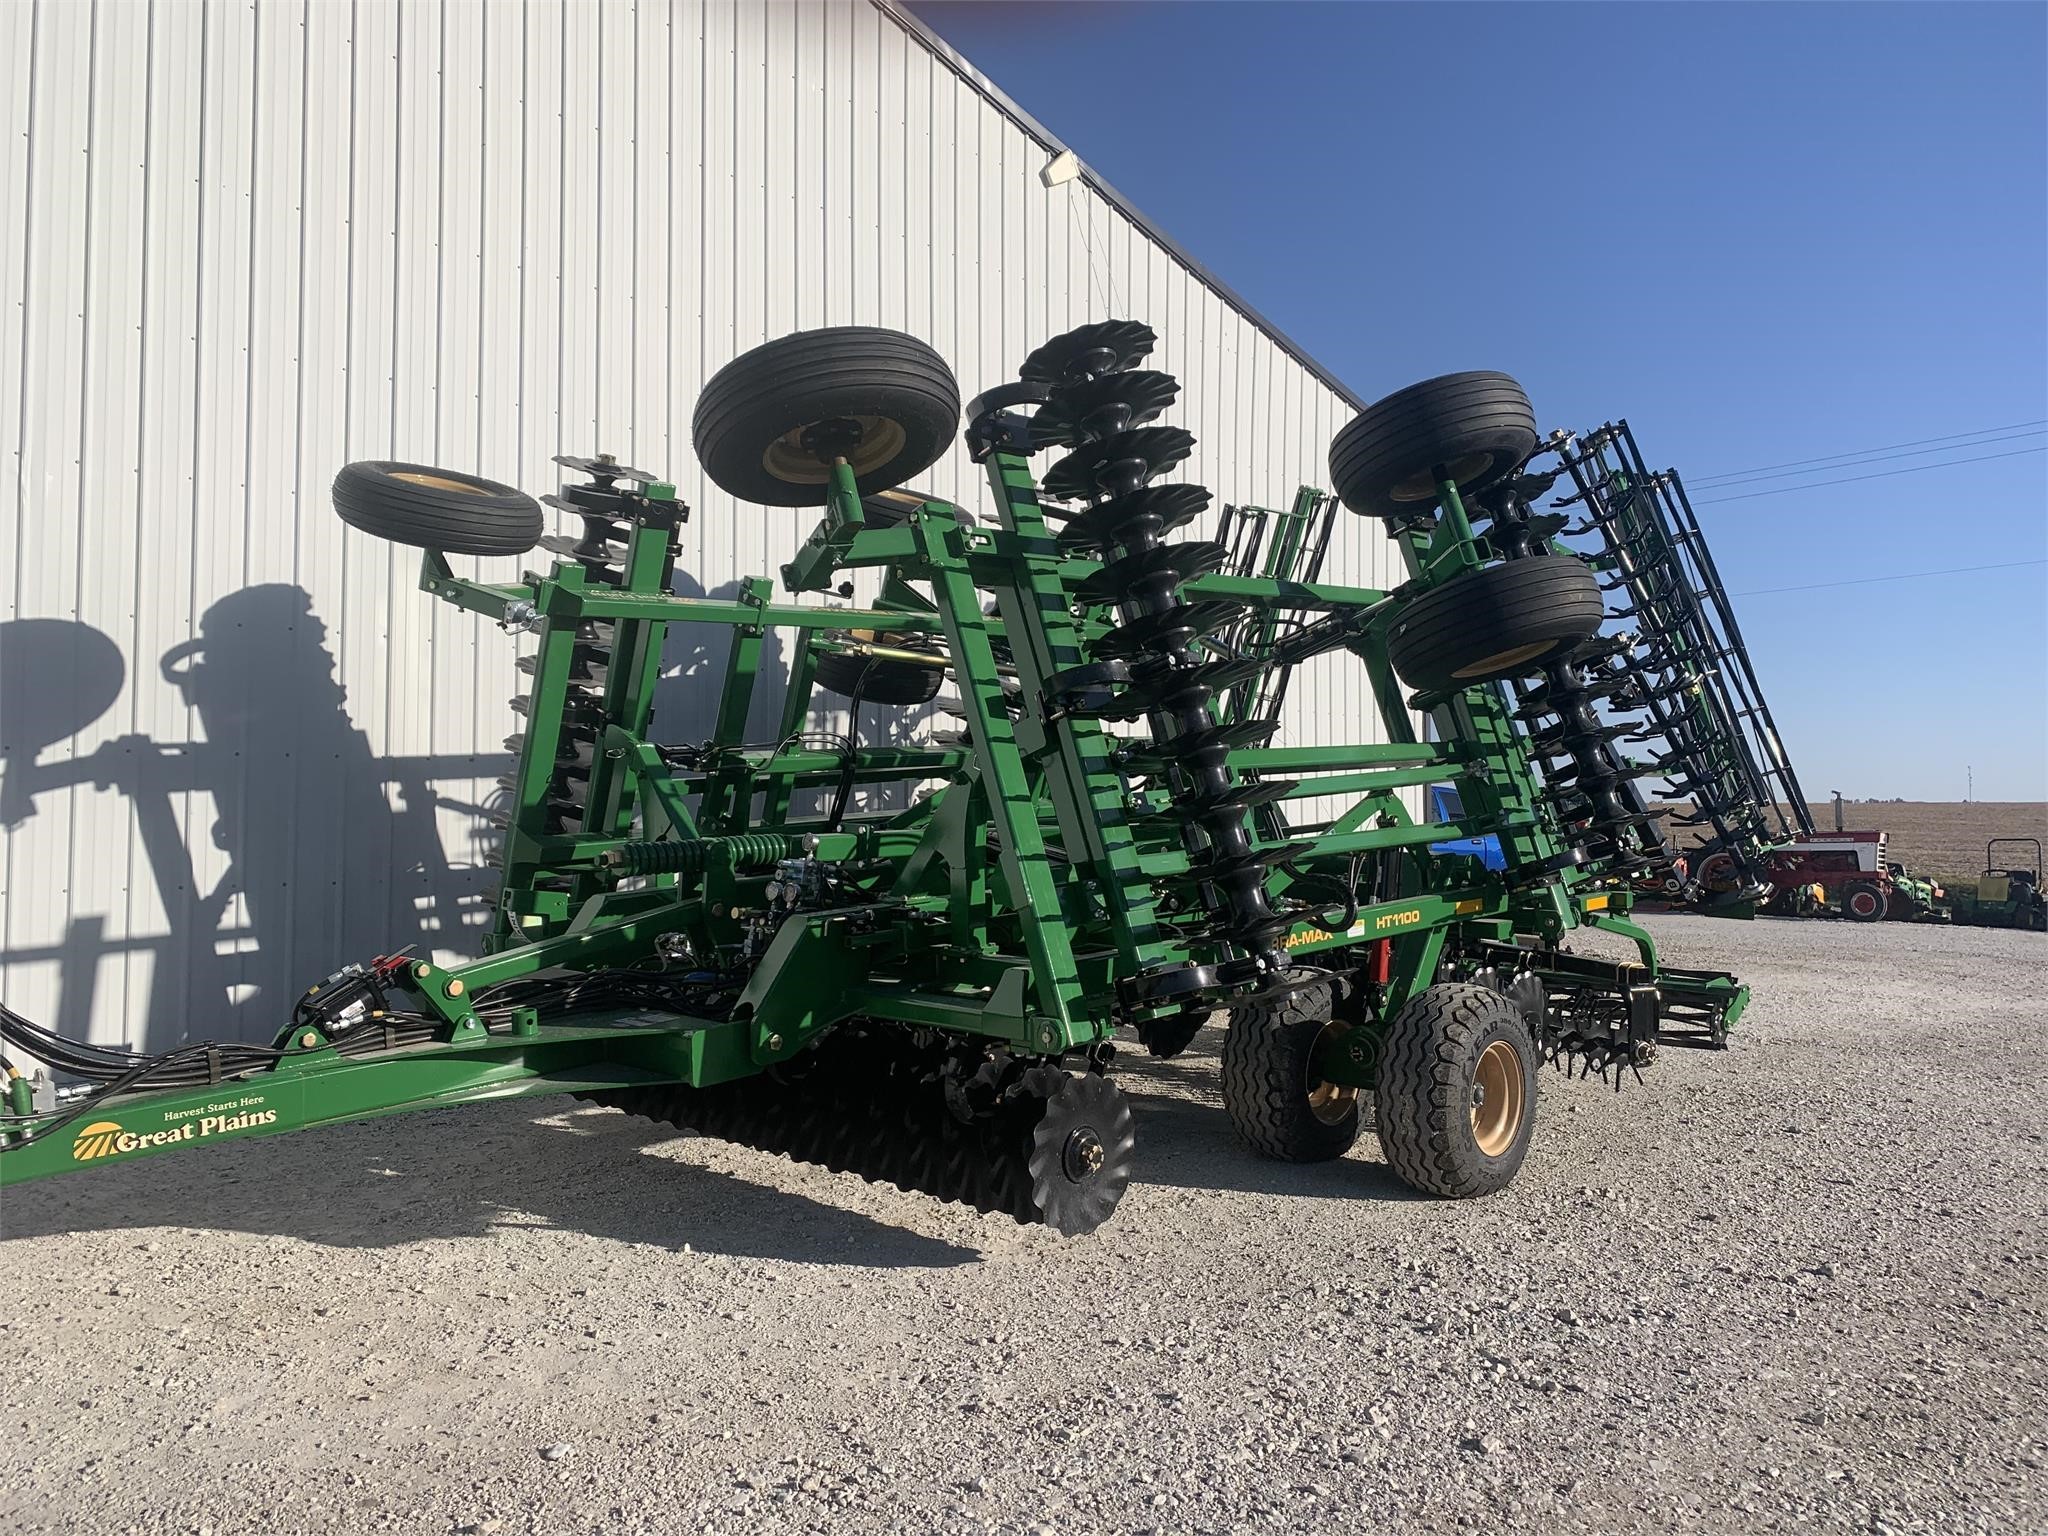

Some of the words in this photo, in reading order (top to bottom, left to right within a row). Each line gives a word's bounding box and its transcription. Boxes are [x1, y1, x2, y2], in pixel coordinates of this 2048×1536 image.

[1376, 910, 1420, 929] HT1100
[164, 1105, 205, 1121] Harvest
[207, 1100, 238, 1113] Starts
[240, 1095, 265, 1107] Here
[115, 1122, 195, 1153] Great
[198, 1109, 277, 1137] Plains
